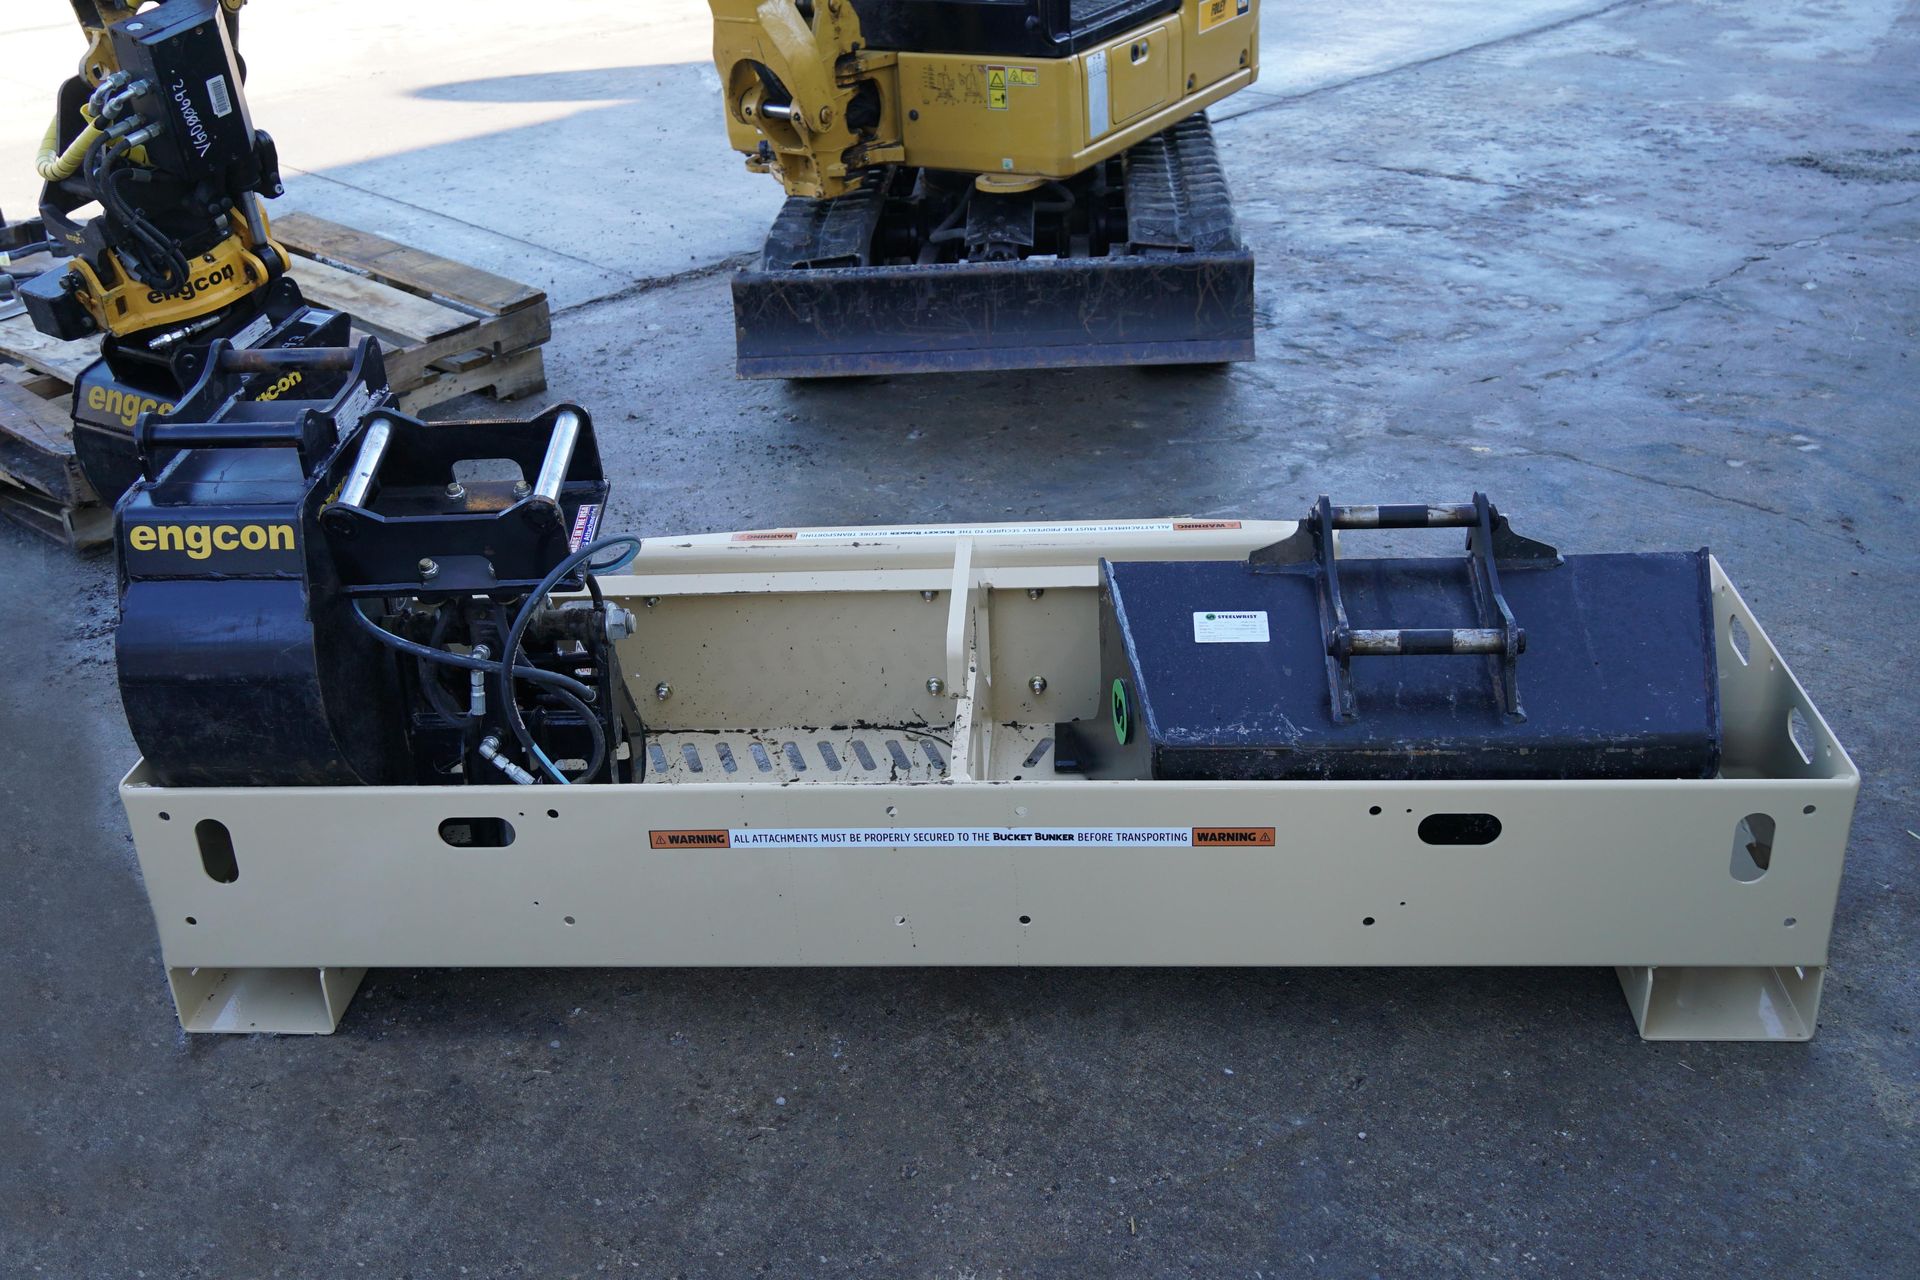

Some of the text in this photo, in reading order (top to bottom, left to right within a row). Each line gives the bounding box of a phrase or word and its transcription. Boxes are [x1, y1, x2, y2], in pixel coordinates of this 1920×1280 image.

[147, 264, 234, 304] engcon
[256, 371, 302, 401] con
[89, 386, 175, 427] engc
[129, 524, 296, 560] engcon
[668, 834, 726, 844] WARNING
[734, 834, 750, 844] ALL
[752, 834, 819, 844] ATTACHMENTS
[821, 833, 846, 843] MUST
[850, 832, 862, 842] BE
[864, 832, 910, 842] PROPERLY
[914, 832, 954, 842] SECURED
[957, 832, 970, 842] TO
[972, 832, 990, 842] THE
[1078, 832, 1113, 842] BEFORE
[1116, 832, 1188, 842] TRANSPORTING
[1197, 832, 1256, 842] WARNING
